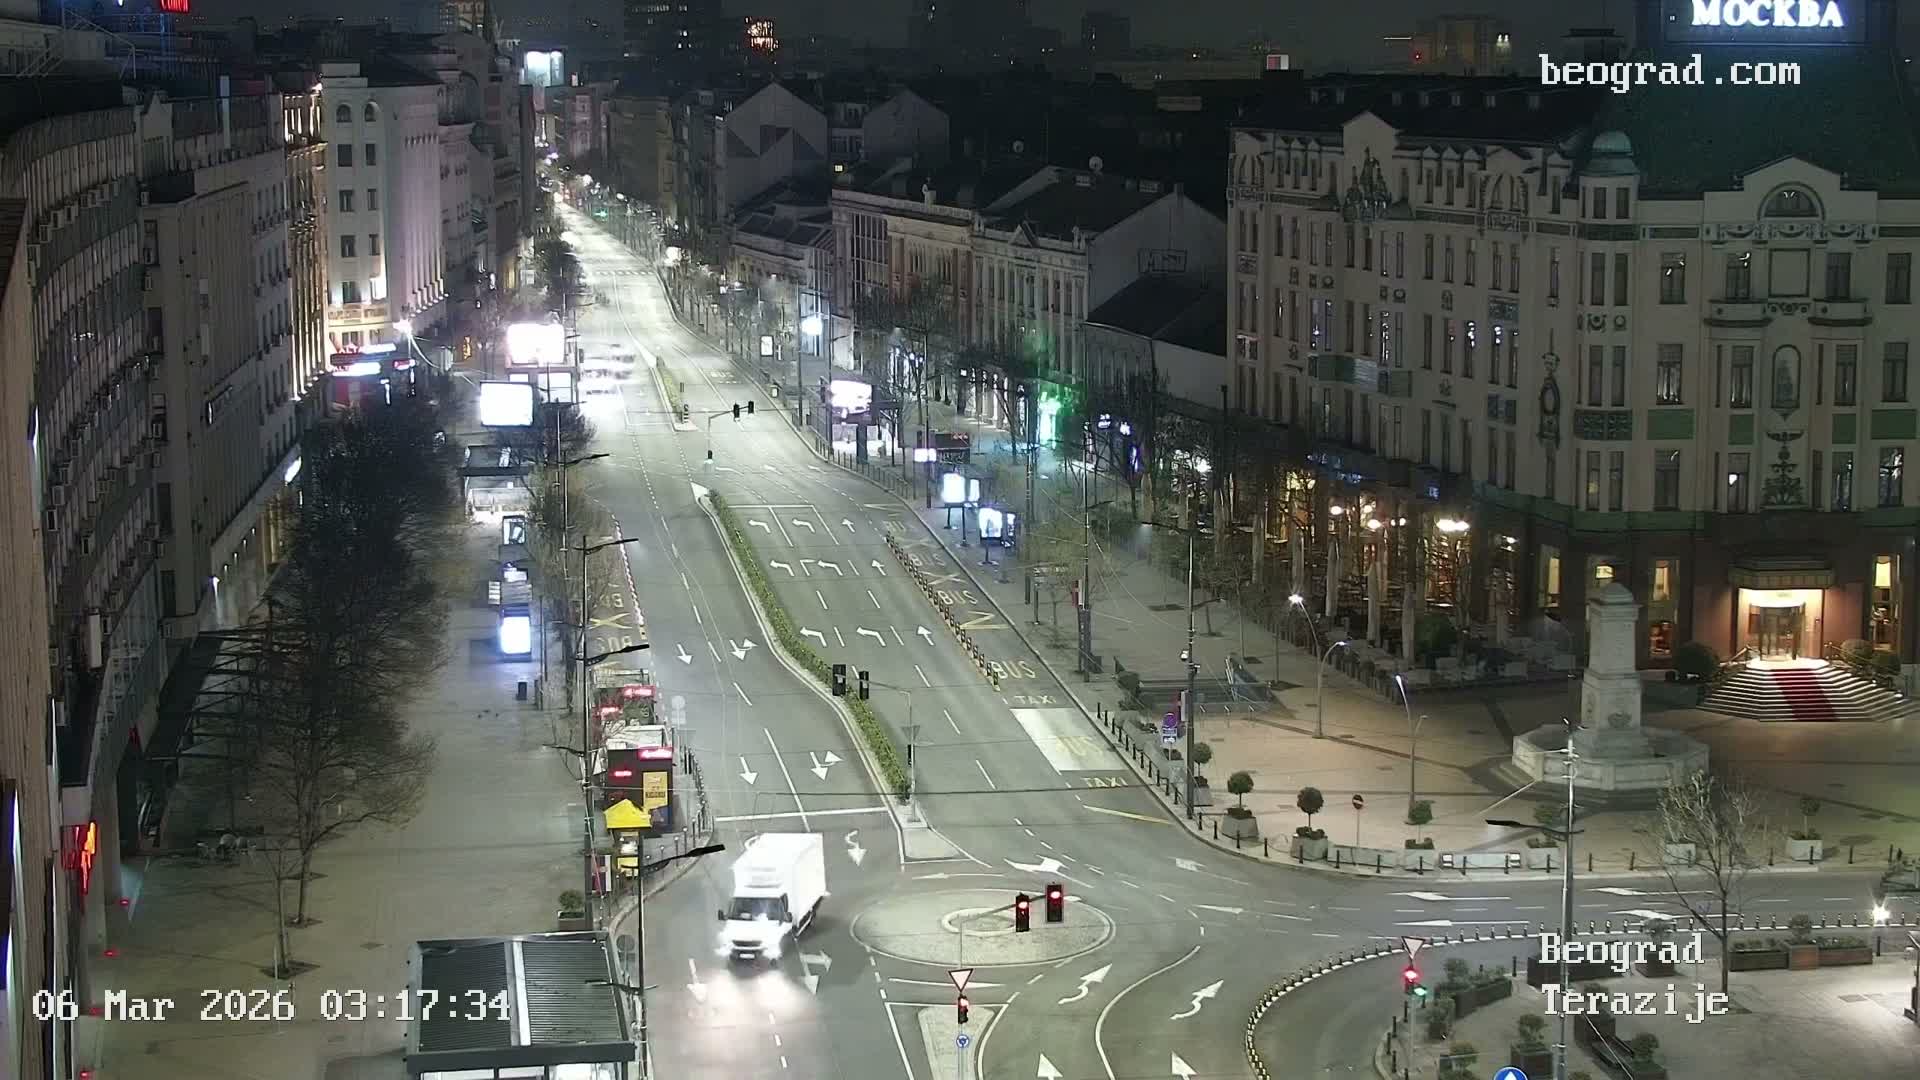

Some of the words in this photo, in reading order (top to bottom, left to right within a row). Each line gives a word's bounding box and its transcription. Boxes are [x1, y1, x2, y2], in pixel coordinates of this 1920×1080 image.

[1691, 0, 1845, 27] МОСКВА
[937, 590, 978, 605] BUS
[990, 660, 1036, 679] BUS
[1013, 695, 1057, 704] TAXI
[1080, 776, 1129, 788] TAXI
